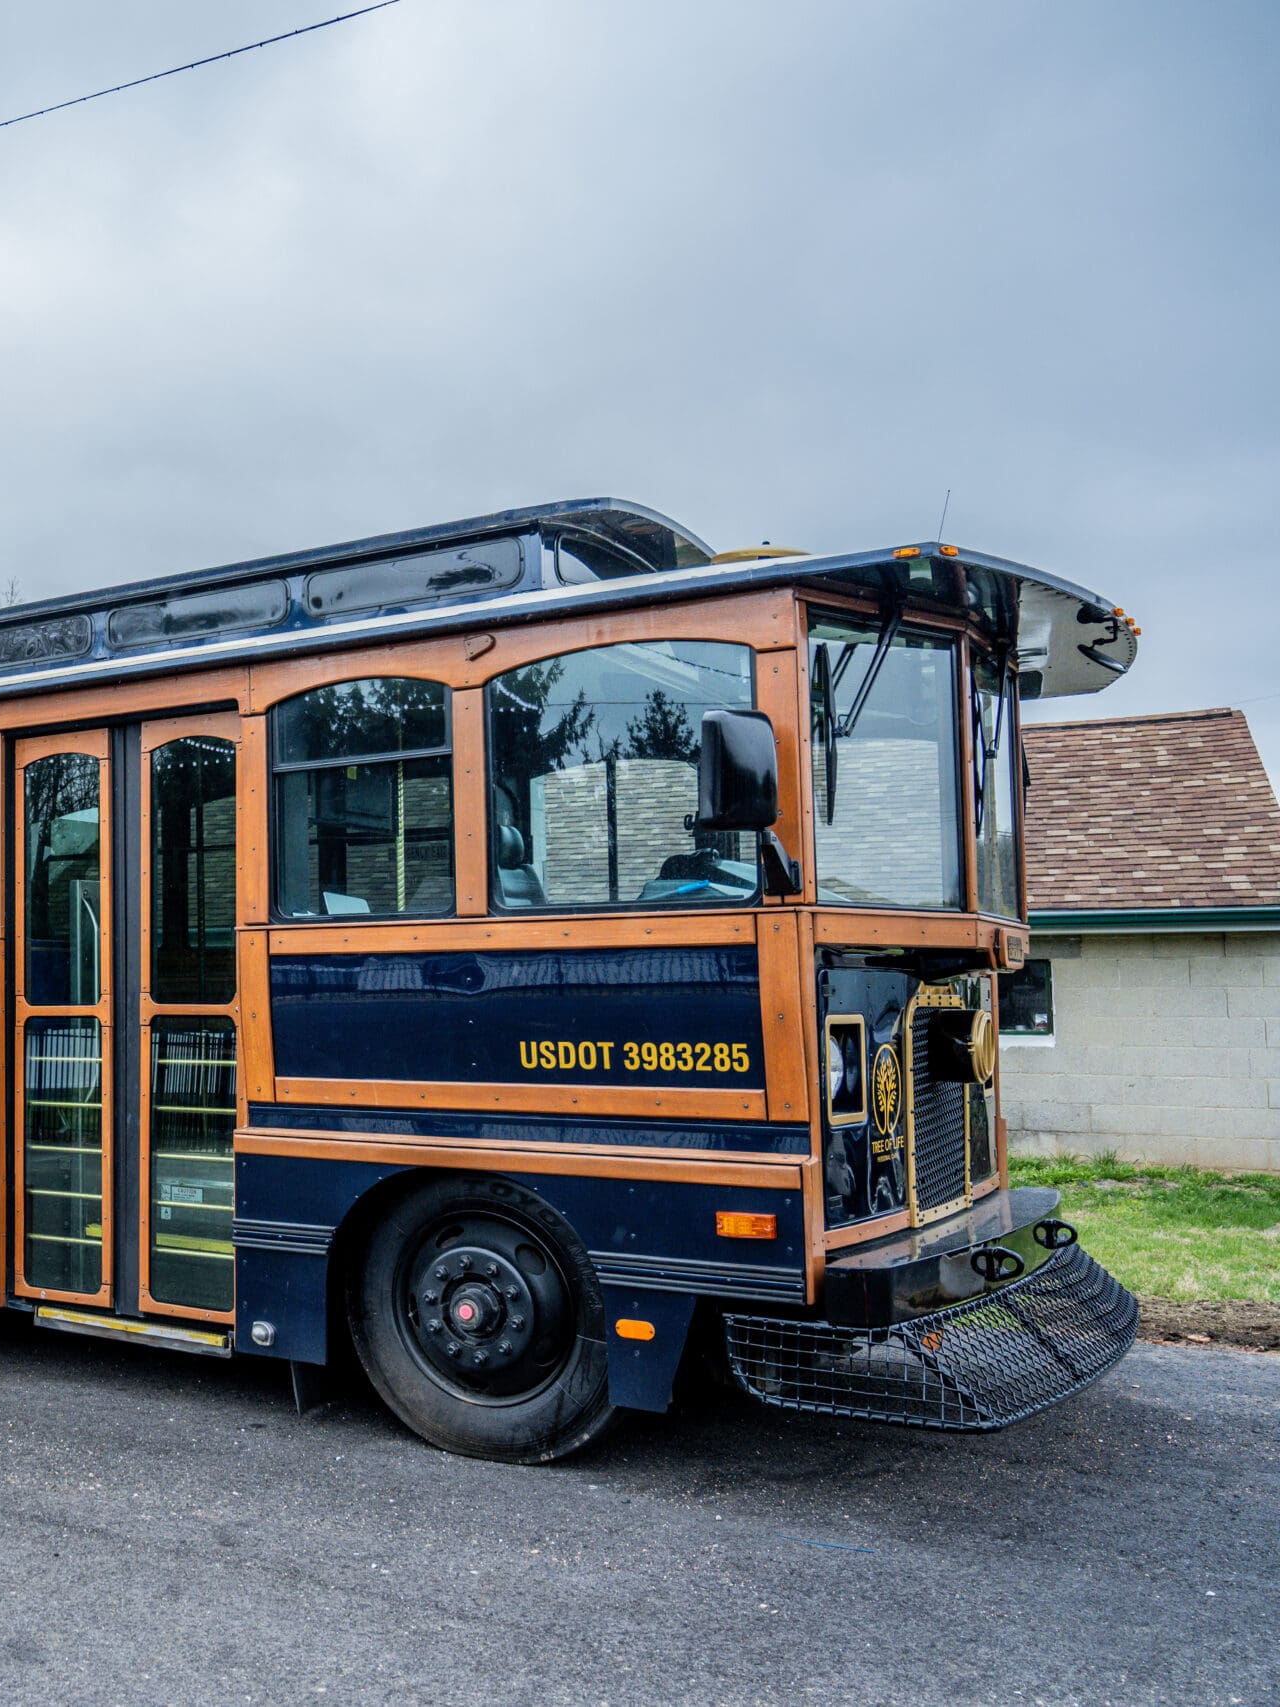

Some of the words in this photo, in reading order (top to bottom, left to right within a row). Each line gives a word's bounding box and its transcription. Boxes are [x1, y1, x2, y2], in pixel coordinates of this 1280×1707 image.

[519, 1040, 615, 1070] USDOT
[623, 1042, 750, 1073] 3983285
[872, 1139, 884, 1154] TREE
[885, 1138, 892, 1151] OF
